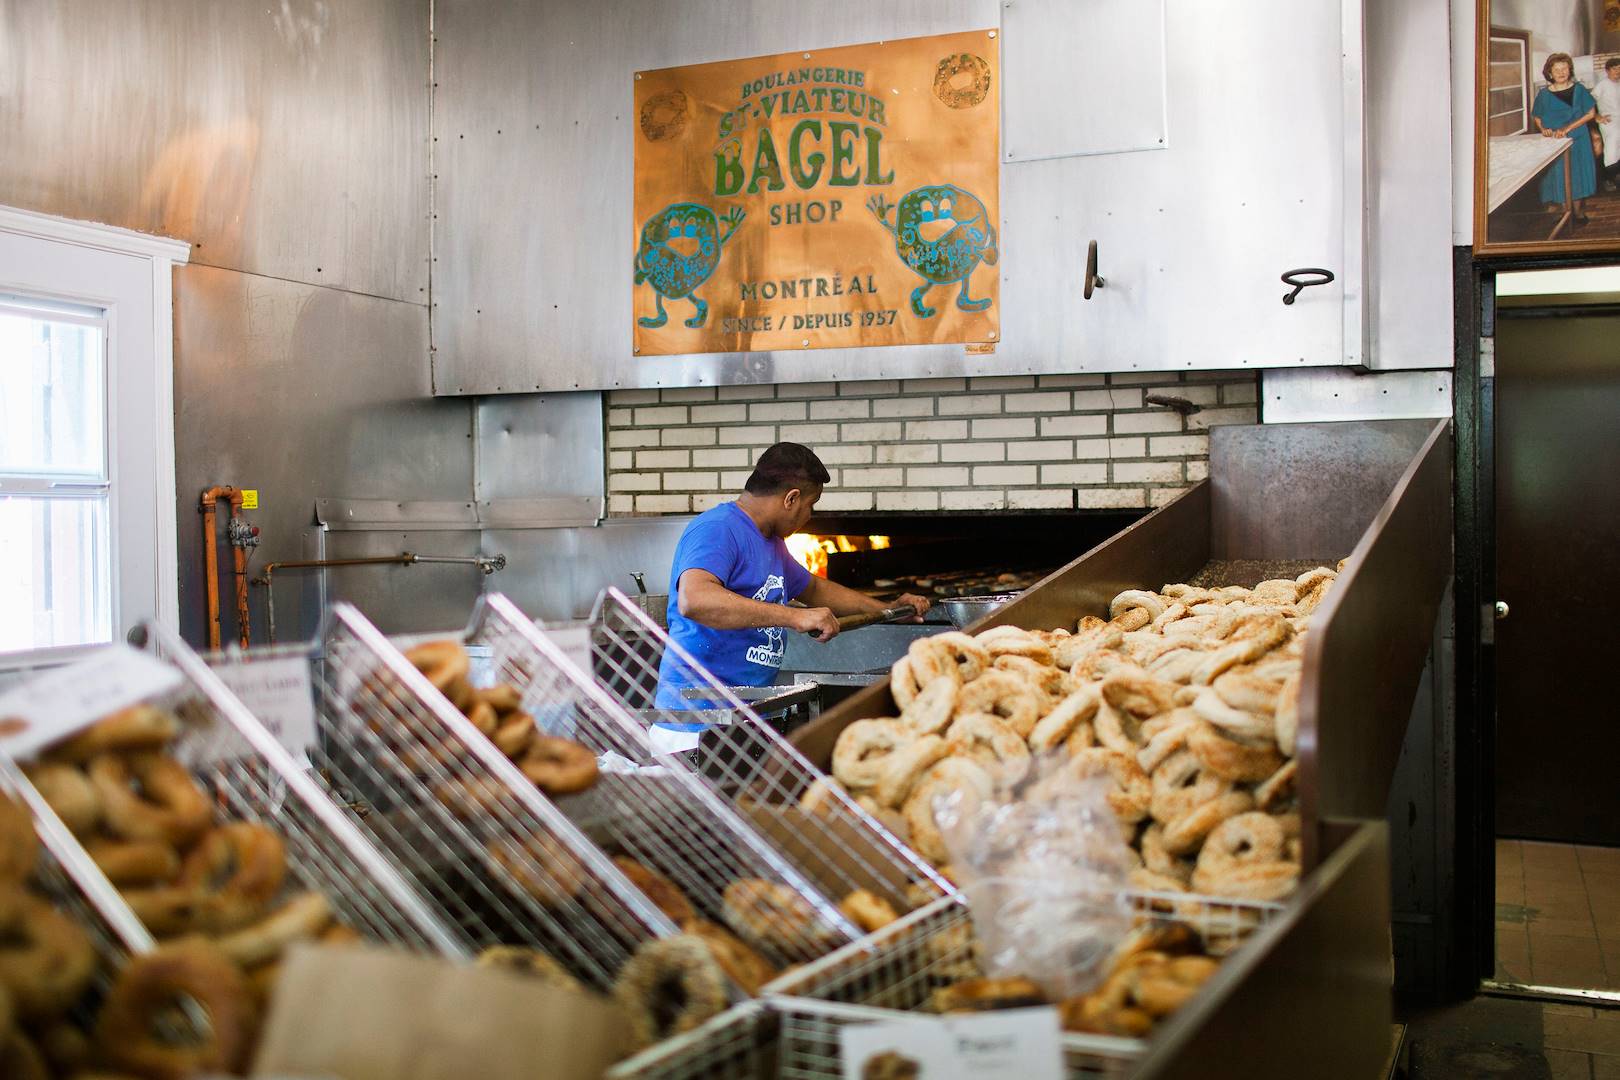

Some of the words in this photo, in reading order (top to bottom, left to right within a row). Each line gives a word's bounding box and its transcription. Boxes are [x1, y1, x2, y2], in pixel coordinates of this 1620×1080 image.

[742, 67, 865, 99] BOULANGERIE
[714, 119, 895, 196] BAGEL
[770, 200, 842, 225] SHOP
[741, 273, 877, 301] MONTRÉAL
[722, 316, 772, 334] SINCE
[793, 312, 853, 330] DEPUIS
[860, 309, 898, 327] 1957
